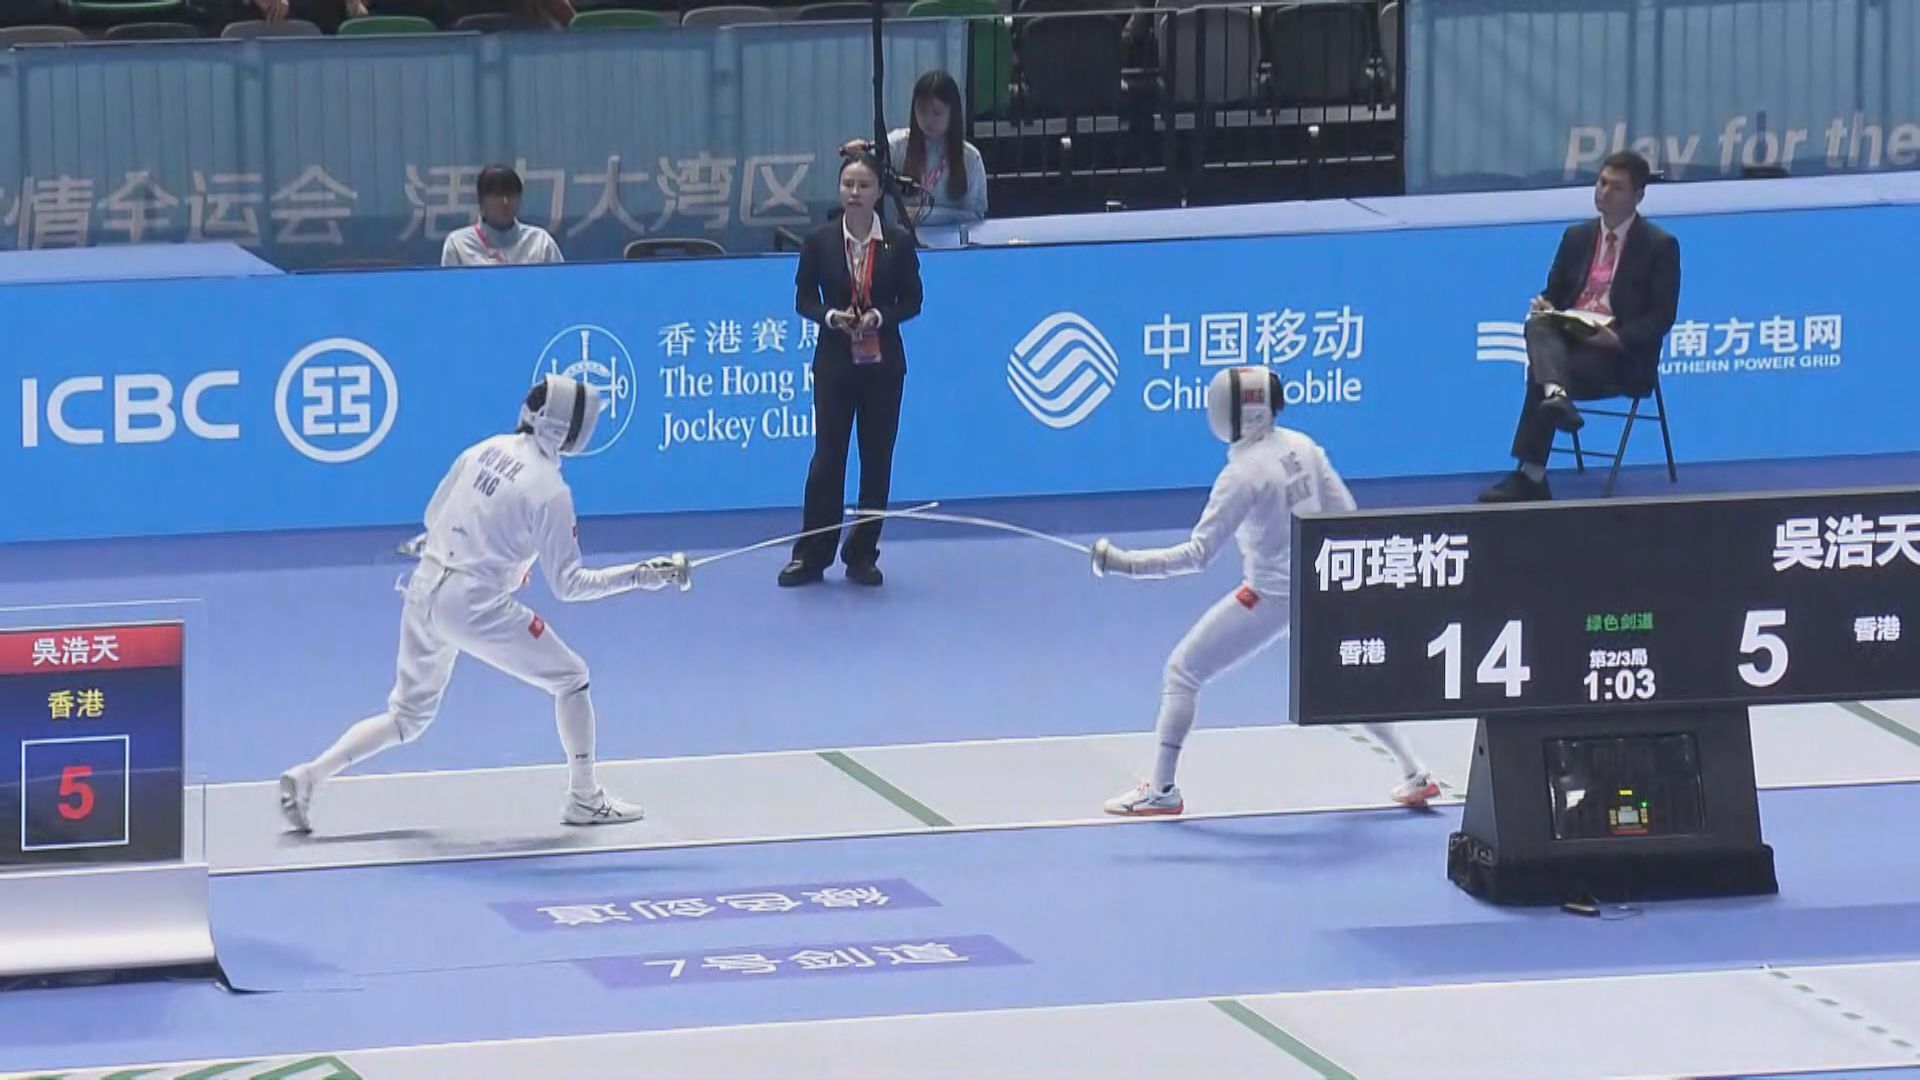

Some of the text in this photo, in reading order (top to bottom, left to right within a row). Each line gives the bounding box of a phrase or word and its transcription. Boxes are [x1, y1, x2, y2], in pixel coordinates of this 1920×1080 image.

[1718, 115, 1807, 176] for
[1825, 111, 1920, 169] the
[0, 163, 358, 250] 情全运会
[1144, 304, 1363, 369] 中国移动
[1661, 314, 1841, 358] 南方电网
[660, 364, 713, 397] The
[721, 366, 795, 401] Hong
[1658, 354, 1840, 375] UTHERN POWER GRID
[22, 369, 241, 449] ICBC
[1143, 376, 1208, 411] Chi
[1280, 368, 1361, 404] obile
[657, 409, 756, 451] Jockey
[1315, 533, 1469, 592] 何瑋桁
[1773, 515, 1920, 573] 吳浩天
[1736, 609, 1789, 688] 5
[1854, 615, 1901, 642] 香港
[32, 634, 120, 667] 吳浩天
[1338, 637, 1387, 665] 香港
[1426, 619, 1531, 700] 14
[1589, 647, 1649, 669] 第2/3局
[48, 688, 105, 720] 香港
[1583, 667, 1657, 701] 1:03
[57, 765, 95, 820] 5
